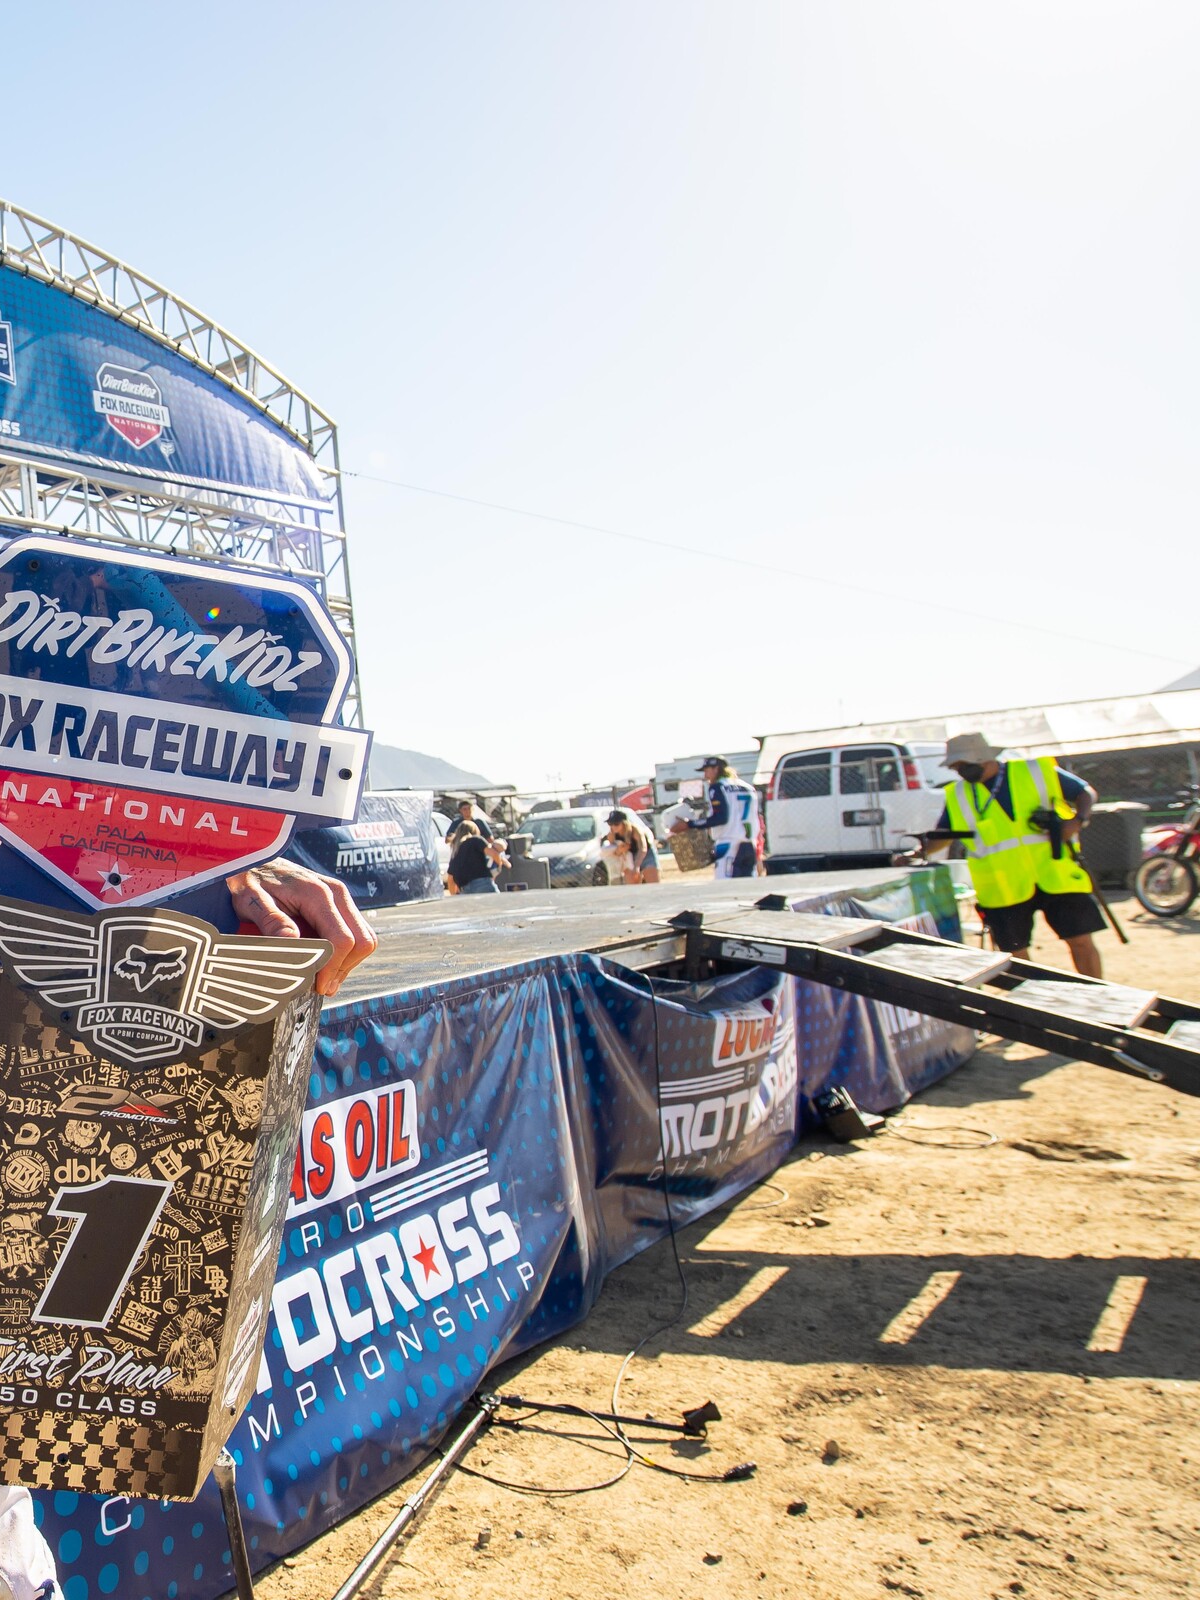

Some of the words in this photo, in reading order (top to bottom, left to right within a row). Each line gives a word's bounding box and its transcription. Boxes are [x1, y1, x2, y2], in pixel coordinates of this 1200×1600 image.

[100, 396, 118, 411] FOX
[119, 402, 161, 421] RACEWAY
[113, 417, 157, 432] NATIONAL
[48, 703, 307, 793] RACEWAY
[1, 781, 249, 837] NATIONAL
[95, 824, 147, 843] PALA
[60, 834, 178, 864] CALIFORNIA
[336, 843, 425, 867] MOTOCROSS
[87, 1007, 116, 1024] FOX
[122, 1007, 194, 1037] RACEWAY
[136, 1032, 168, 1042] COMPANY
[20, 1065, 42, 1076] DIRT
[47, 1061, 70, 1073] BIKE
[100, 1110, 179, 1125] PROMOTIONS
[178, 1139, 204, 1153] DBK
[344, 1087, 412, 1183] OIL
[54, 1158, 107, 1184] dbk
[32, 1174, 175, 1329] 1
[69, 1346, 181, 1391] Place
[56, 1392, 157, 1417] CLASS
